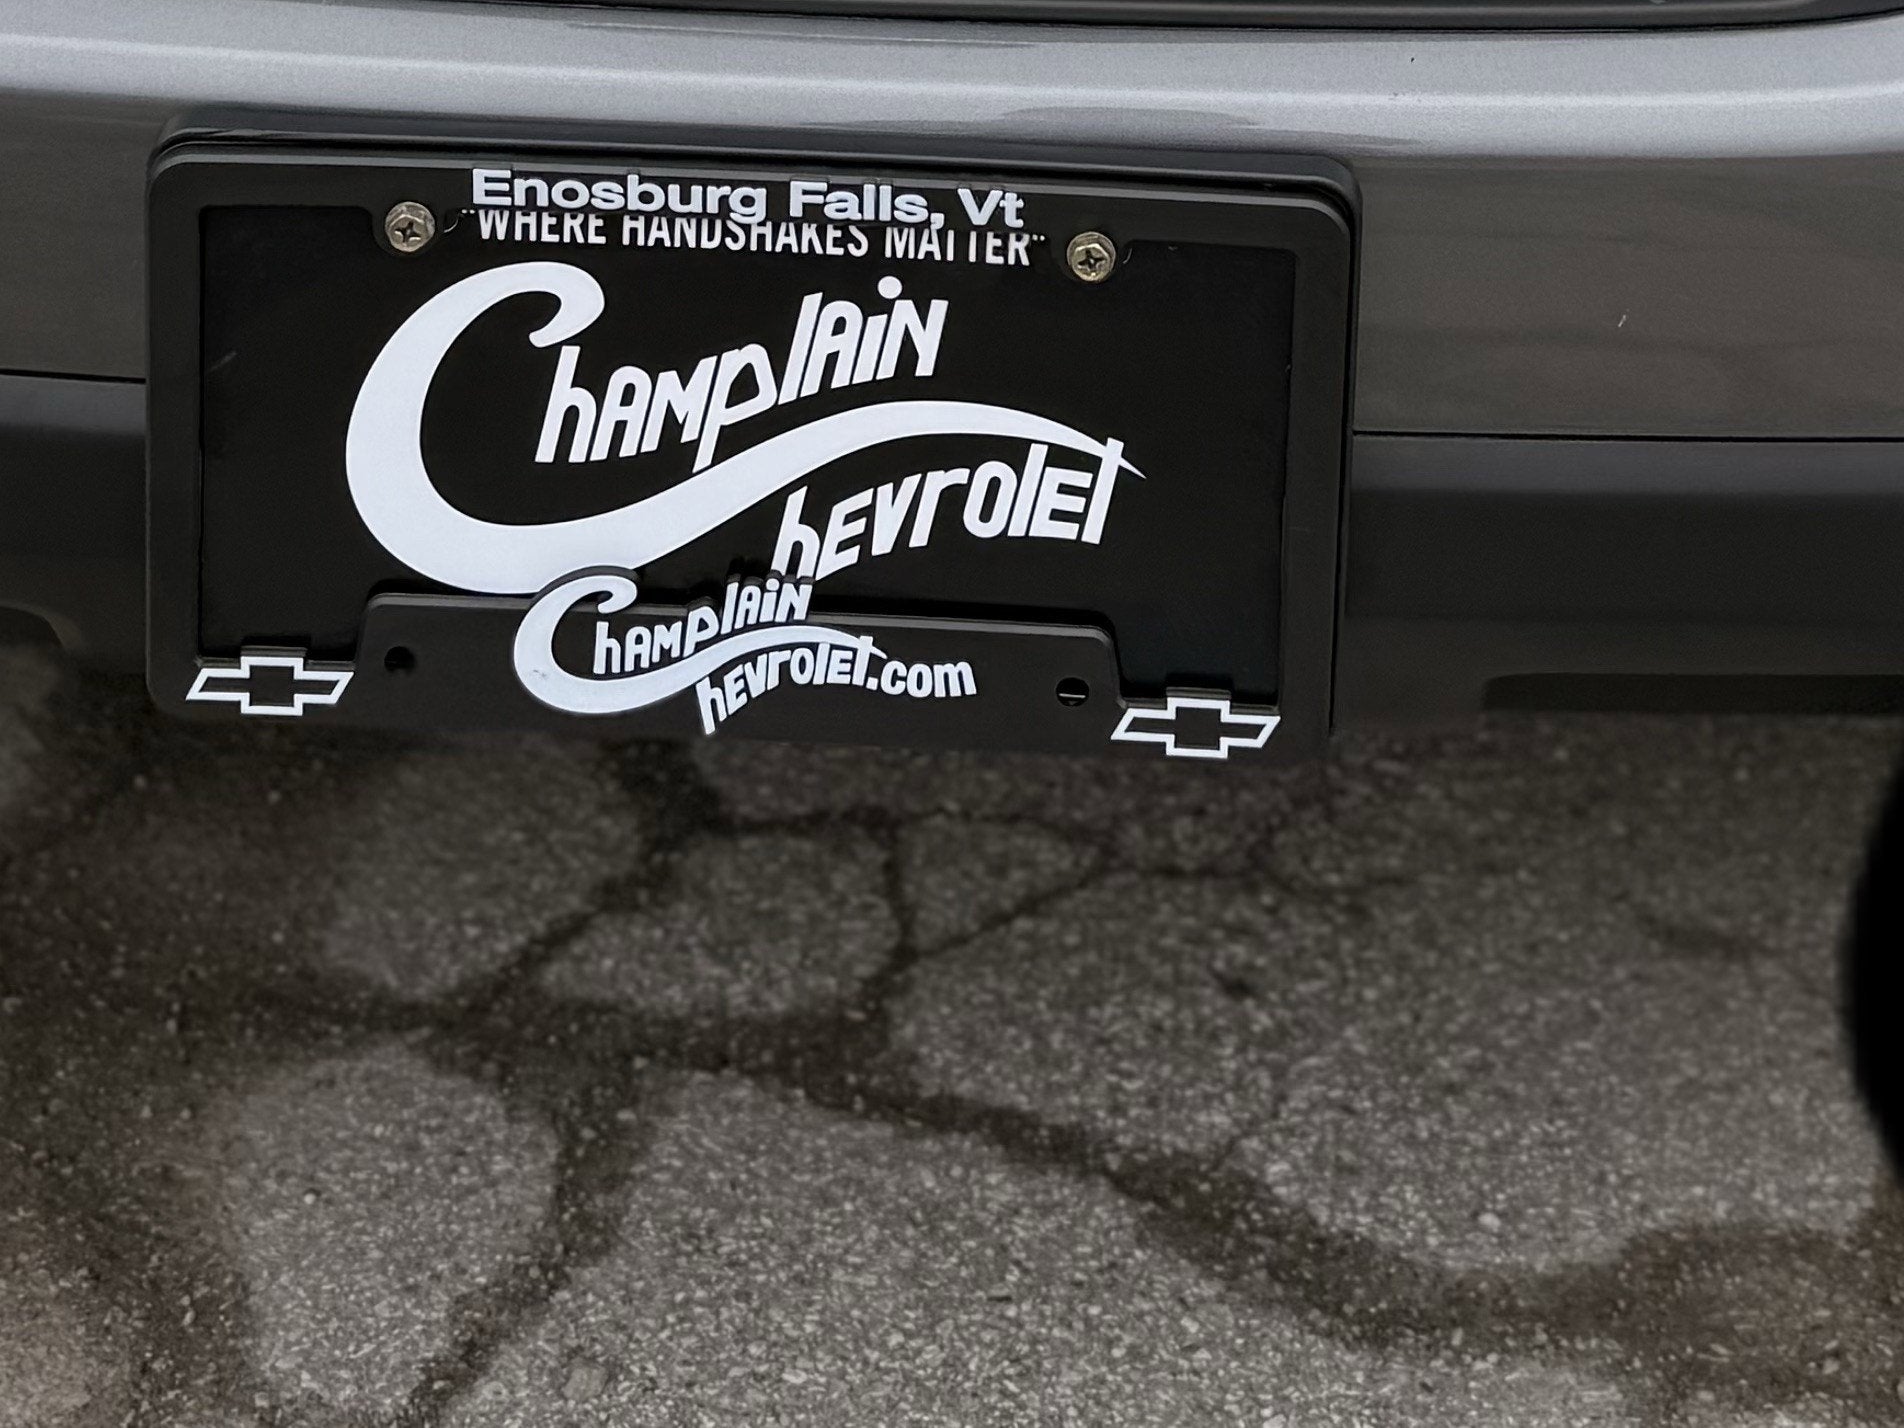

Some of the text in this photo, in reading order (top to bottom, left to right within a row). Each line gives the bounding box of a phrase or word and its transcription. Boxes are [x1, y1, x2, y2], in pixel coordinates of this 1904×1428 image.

[472, 168, 1025, 230] Enosburg Falls, Vt
[621, 214, 869, 258] HANDSHAKES
